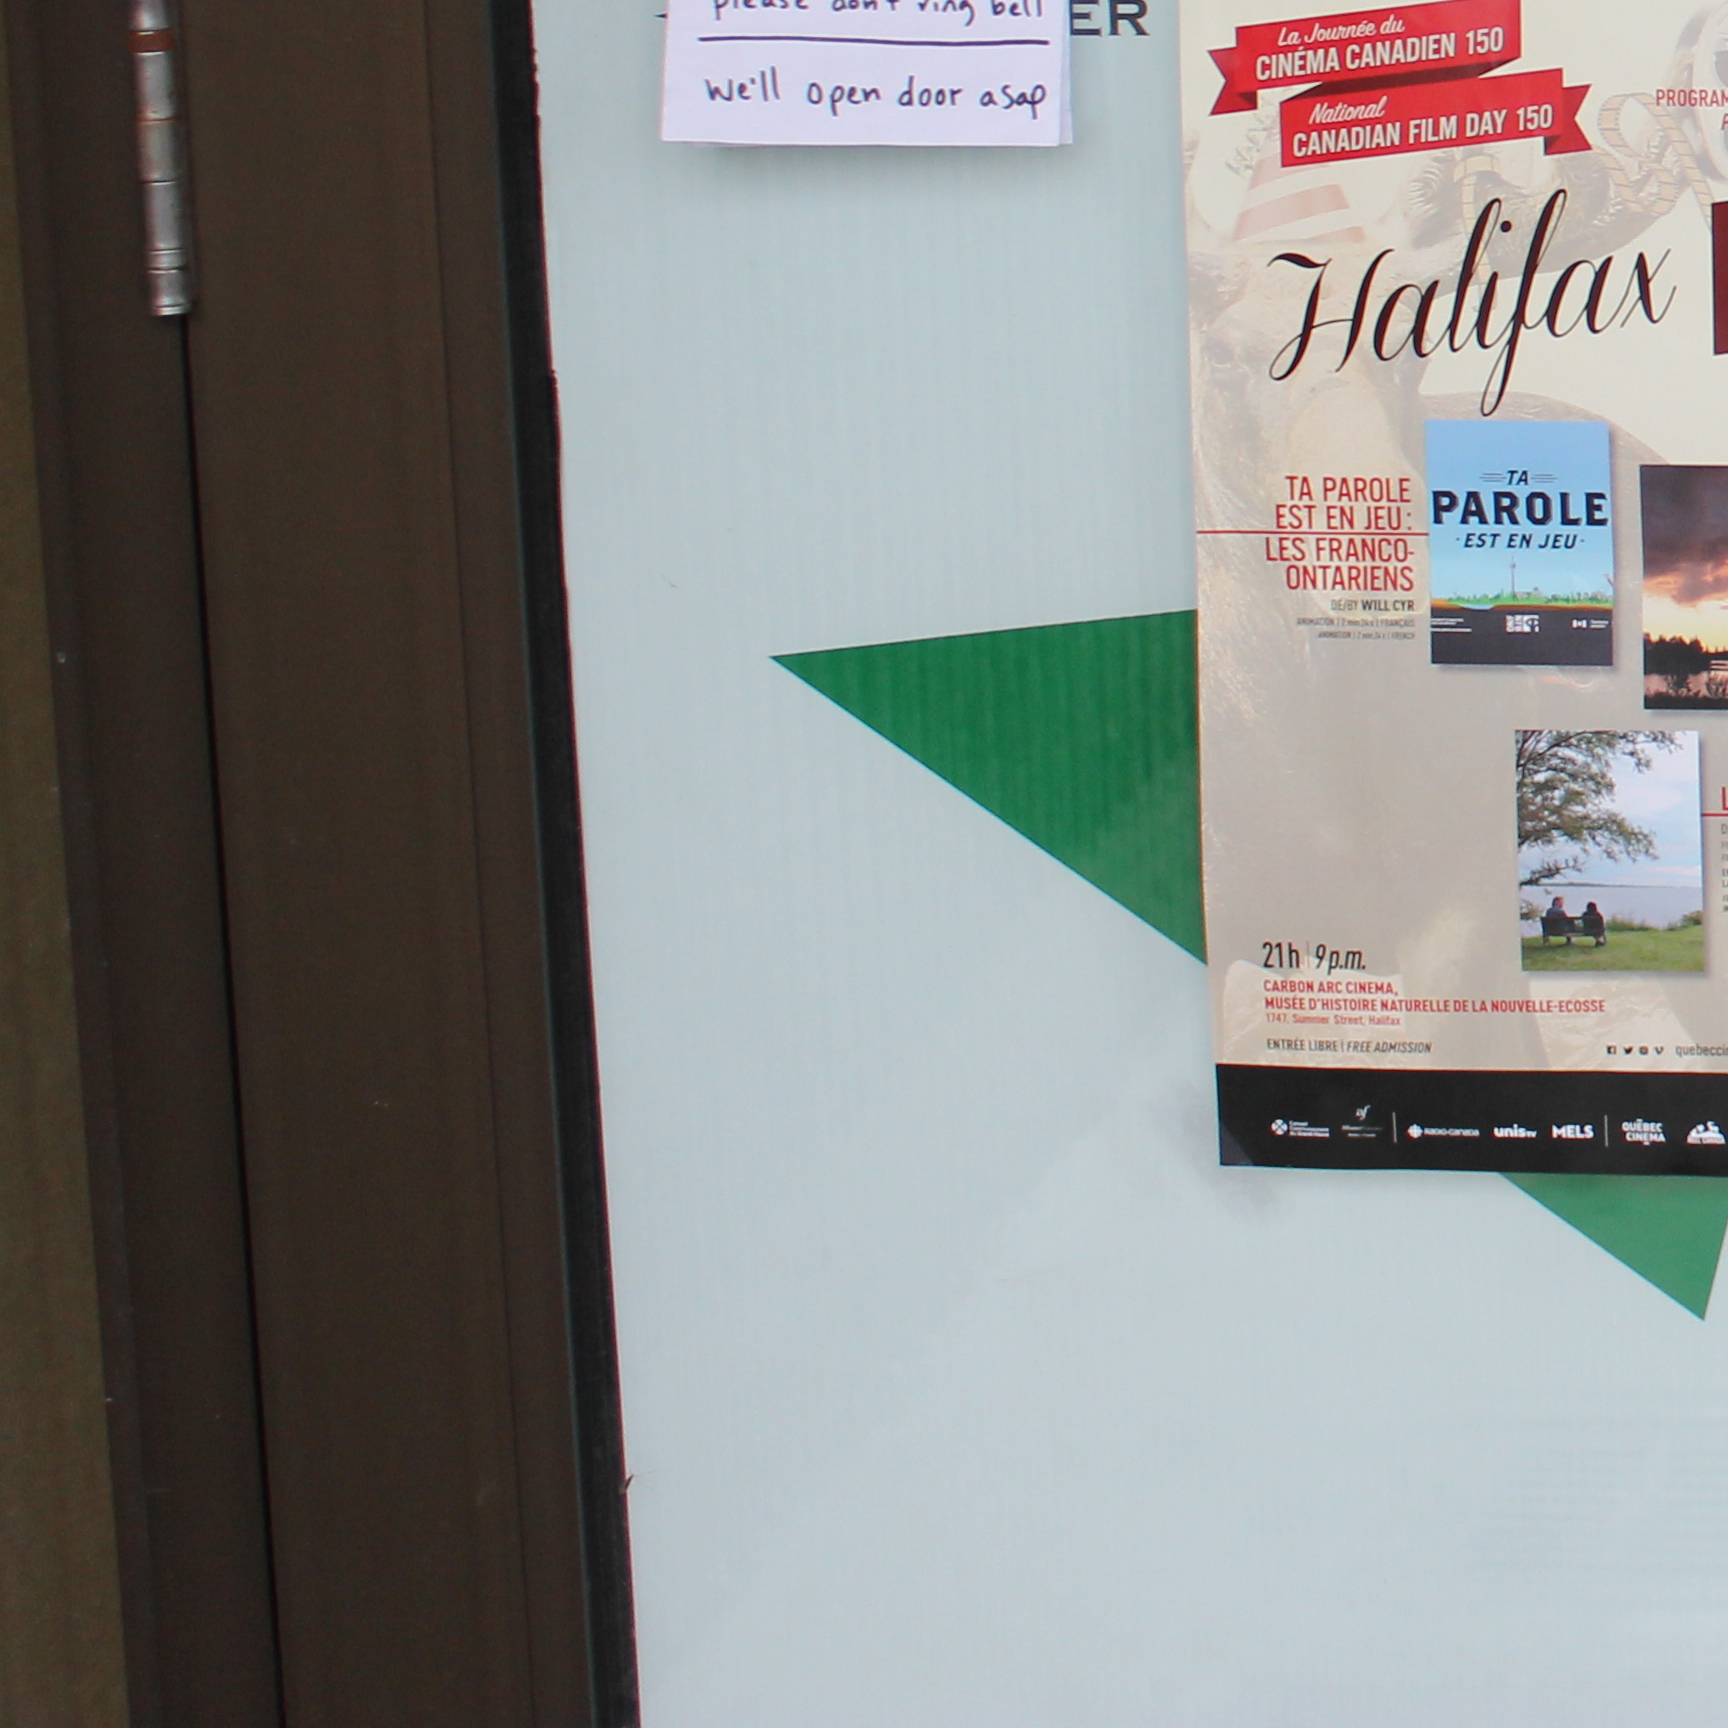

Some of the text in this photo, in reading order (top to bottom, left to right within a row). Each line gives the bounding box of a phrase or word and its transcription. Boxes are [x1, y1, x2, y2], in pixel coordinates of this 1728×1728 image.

[1278, 14, 1405, 46] La Journée du
[1256, 27, 1504, 81] CINÉMA CANADIEN 150
[807, 82, 880, 116] open
[898, 76, 963, 108] door
[980, 83, 1046, 120] asap
[1309, 96, 1388, 125] National
[1293, 105, 1553, 157] CANADIAN FILM DAY 150
[1267, 188, 1677, 417] Halifax
[1286, 476, 1411, 503] TA PAROLE
[1506, 470, 1529, 486] TA
[1276, 504, 1316, 530] EST
[1327, 505, 1351, 530] EN
[1431, 490, 1609, 527] PAROLE
[1266, 537, 1414, 563] LES FRANCO-
[1464, 533, 1578, 549] EST EN JEU
[1286, 565, 1414, 591] ONTARIENS
[1331, 600, 1414, 611] DE/BY WILL CYR
[1262, 942, 1299, 969] 21h
[1264, 980, 1398, 996] CARBON ARC CINEMA,
[1265, 996, 1306, 1010] MUSÉE
[1309, 998, 1378, 1012] D'HISTOIRE
[1381, 999, 1450, 1012] NATURELLE
[1454, 999, 1469, 1012] DE
[1473, 1000, 1488, 1012] LA
[1267, 1038, 1431, 1053] ENTRÉE LIBRE FREE ADMISSION
[1552, 1125, 1594, 1138] MELS
